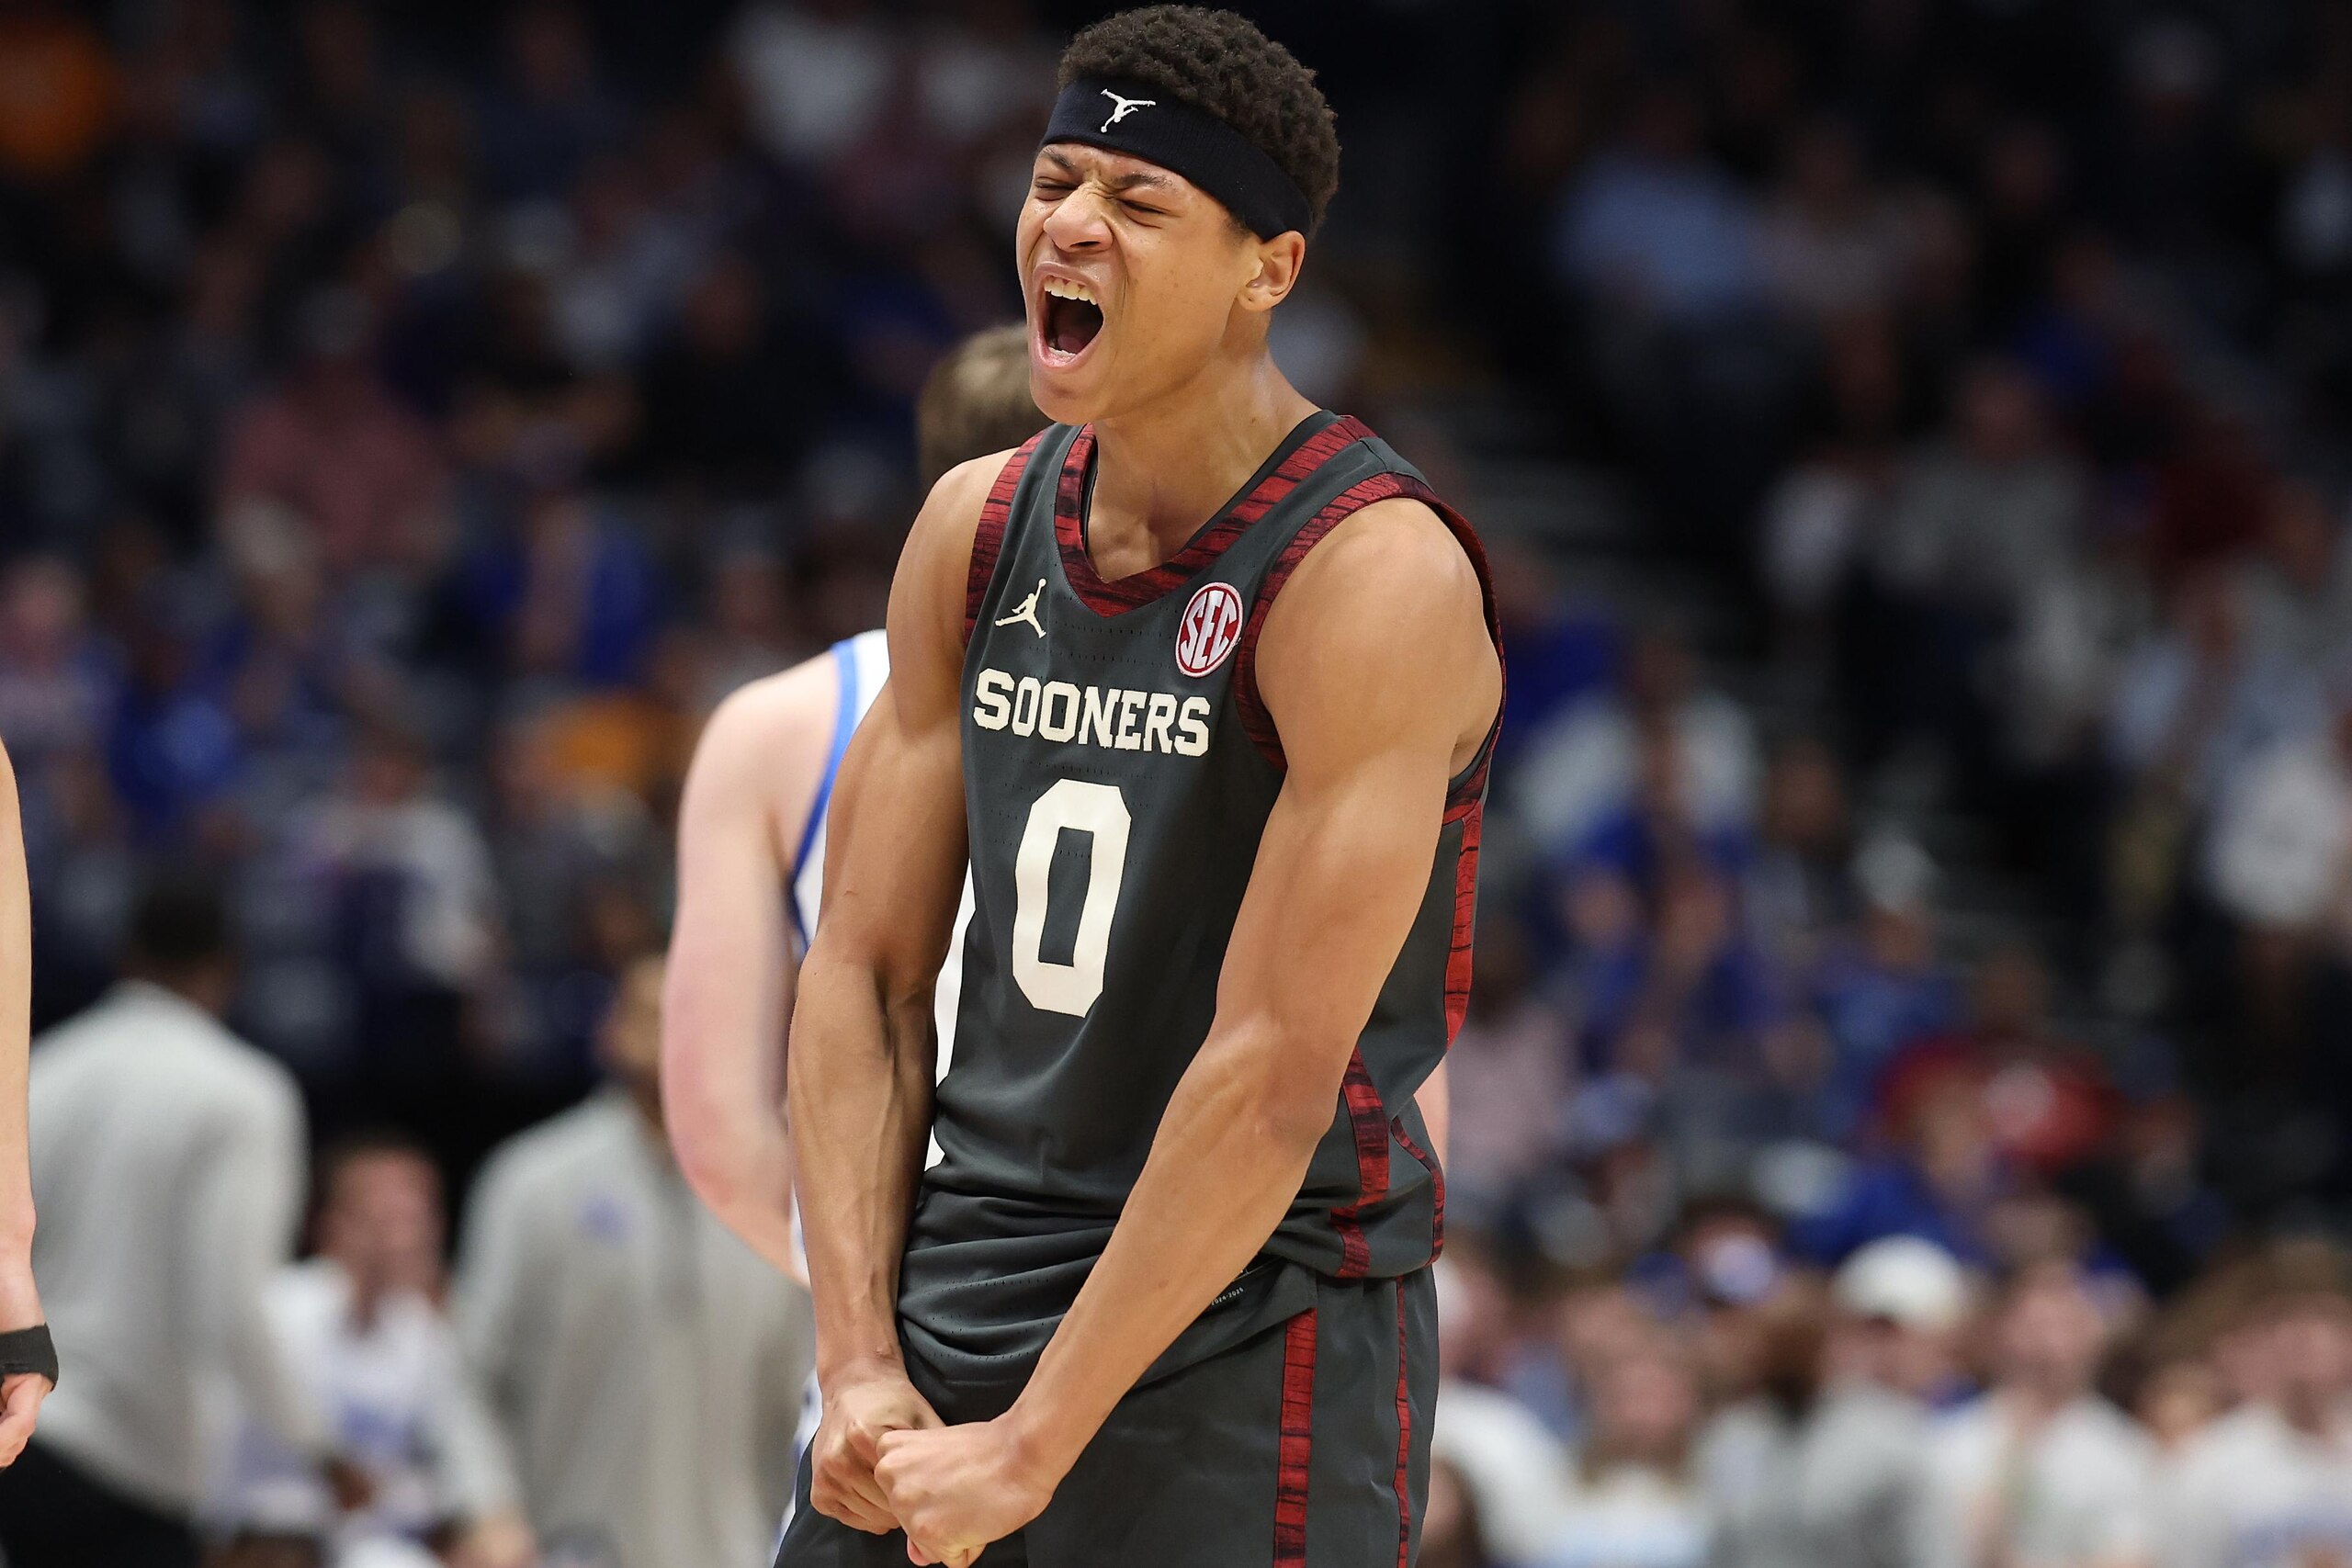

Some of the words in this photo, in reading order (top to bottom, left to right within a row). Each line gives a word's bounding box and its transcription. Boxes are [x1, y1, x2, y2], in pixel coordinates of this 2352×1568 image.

[1181, 590, 1237, 669] SEC
[973, 668, 1210, 757] SOONERS
[1012, 778, 1132, 1018] 0
